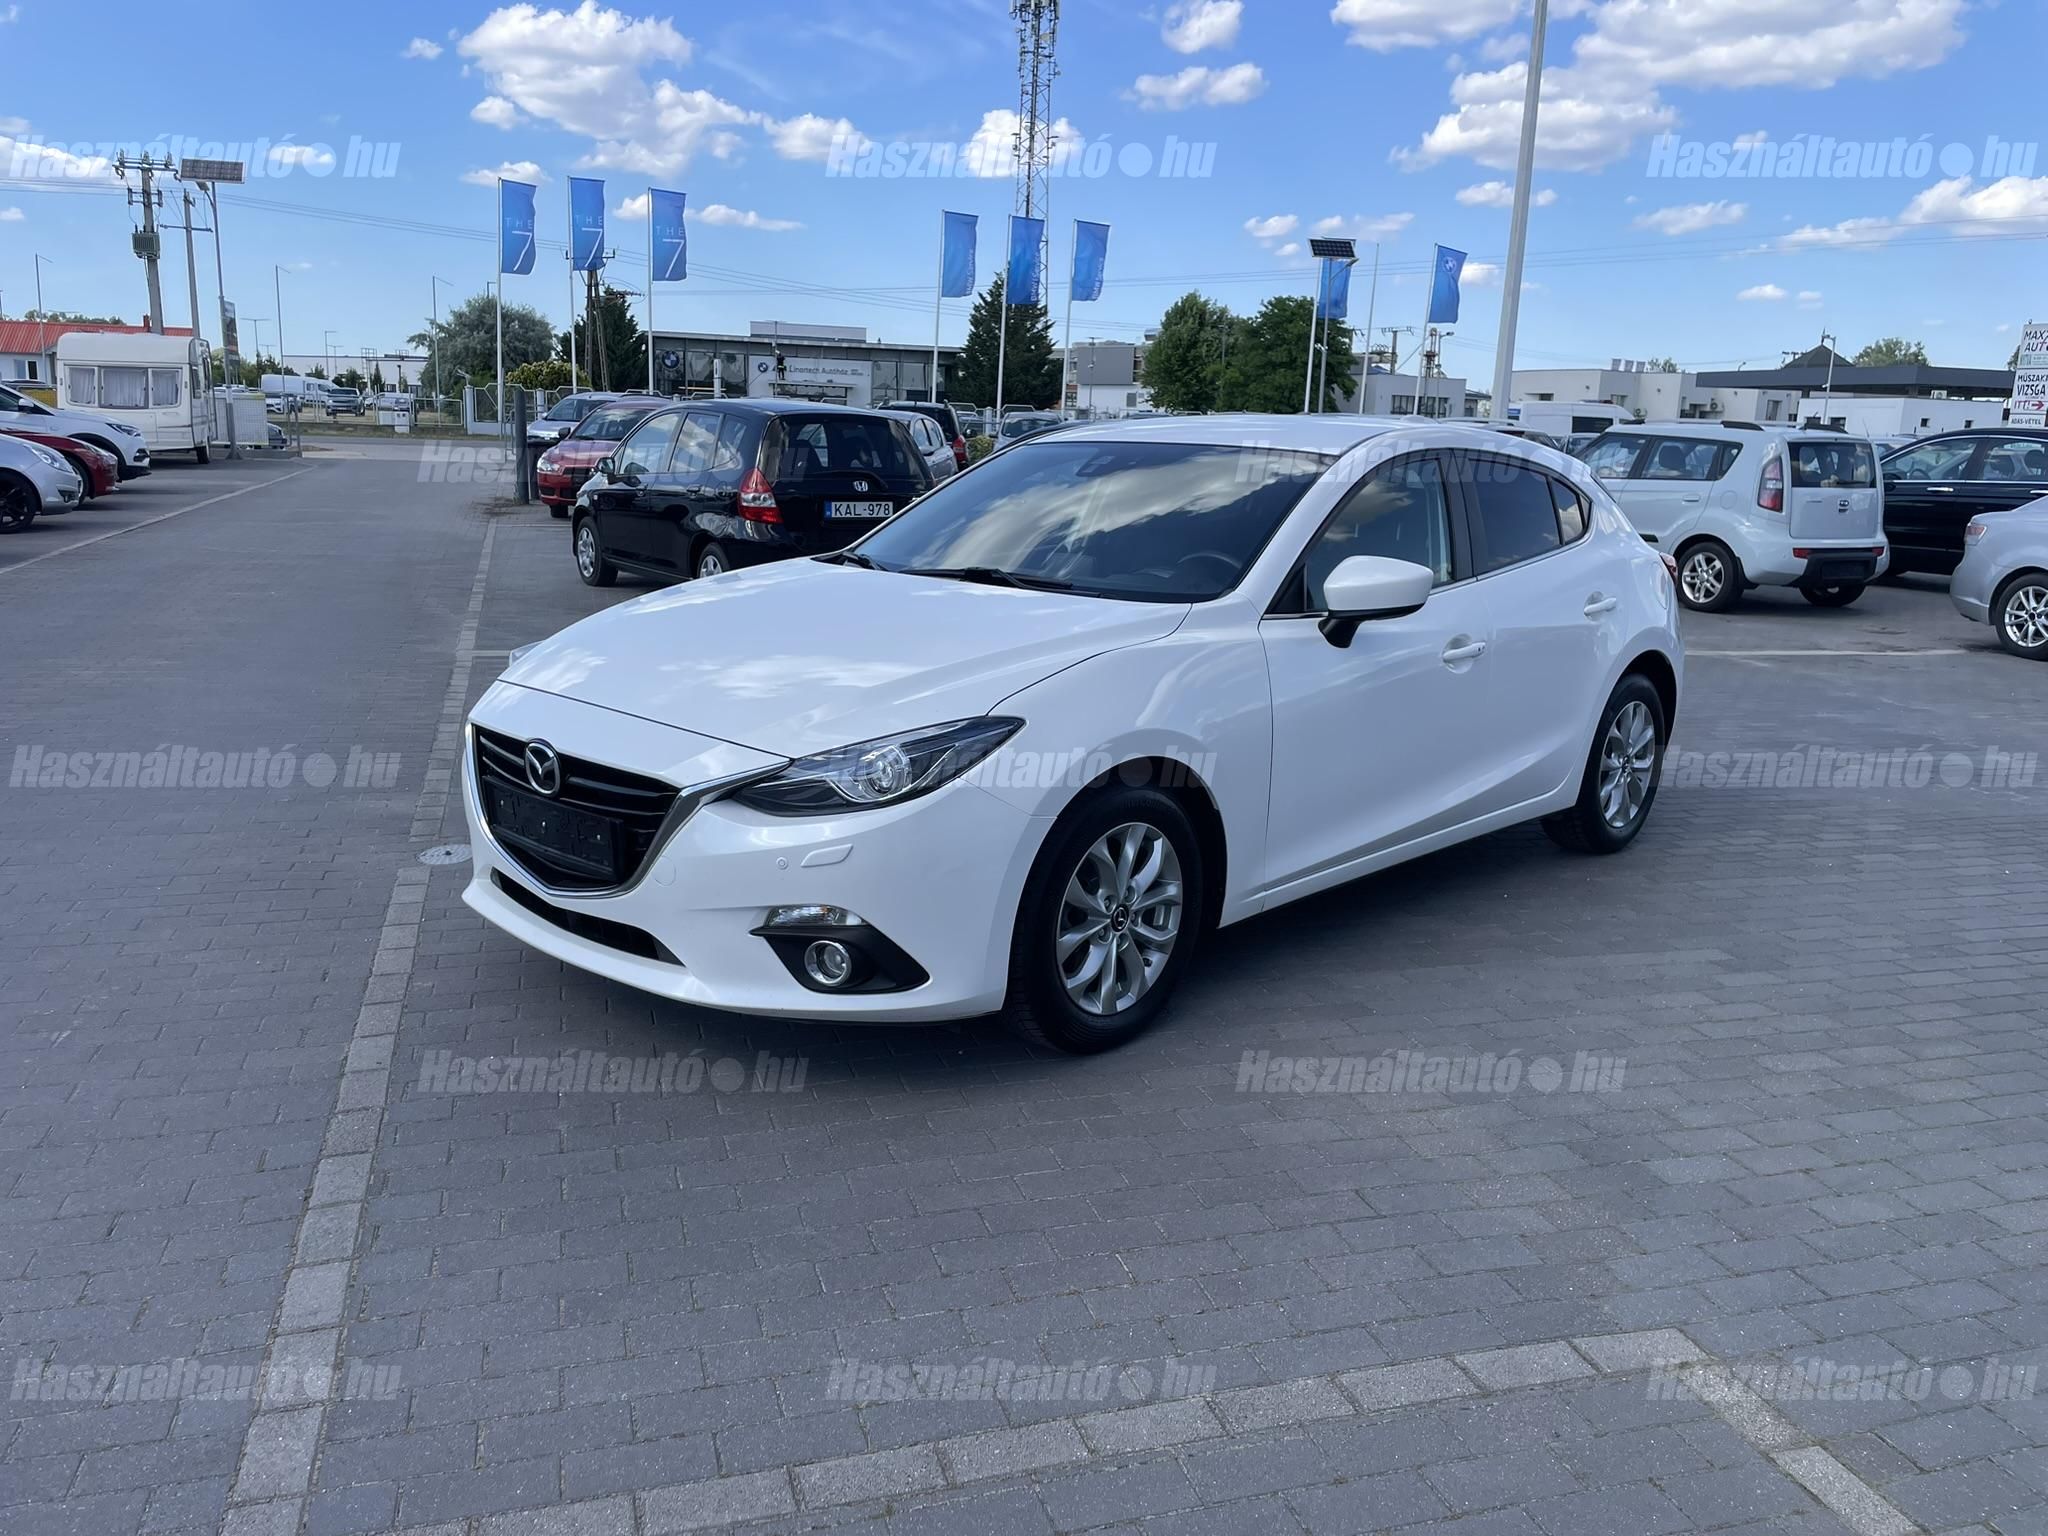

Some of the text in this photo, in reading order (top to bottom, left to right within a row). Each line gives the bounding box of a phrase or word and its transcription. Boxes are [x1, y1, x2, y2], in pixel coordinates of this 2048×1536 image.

[505, 217, 532, 229] THE
[575, 214, 603, 225] THE
[656, 225, 684, 236] THE
[512, 231, 532, 271] 7
[582, 228, 603, 268] 7
[662, 238, 685, 278] 7
[2017, 384, 2046, 396] VIZSGA
[834, 503, 890, 516] KAL-978
